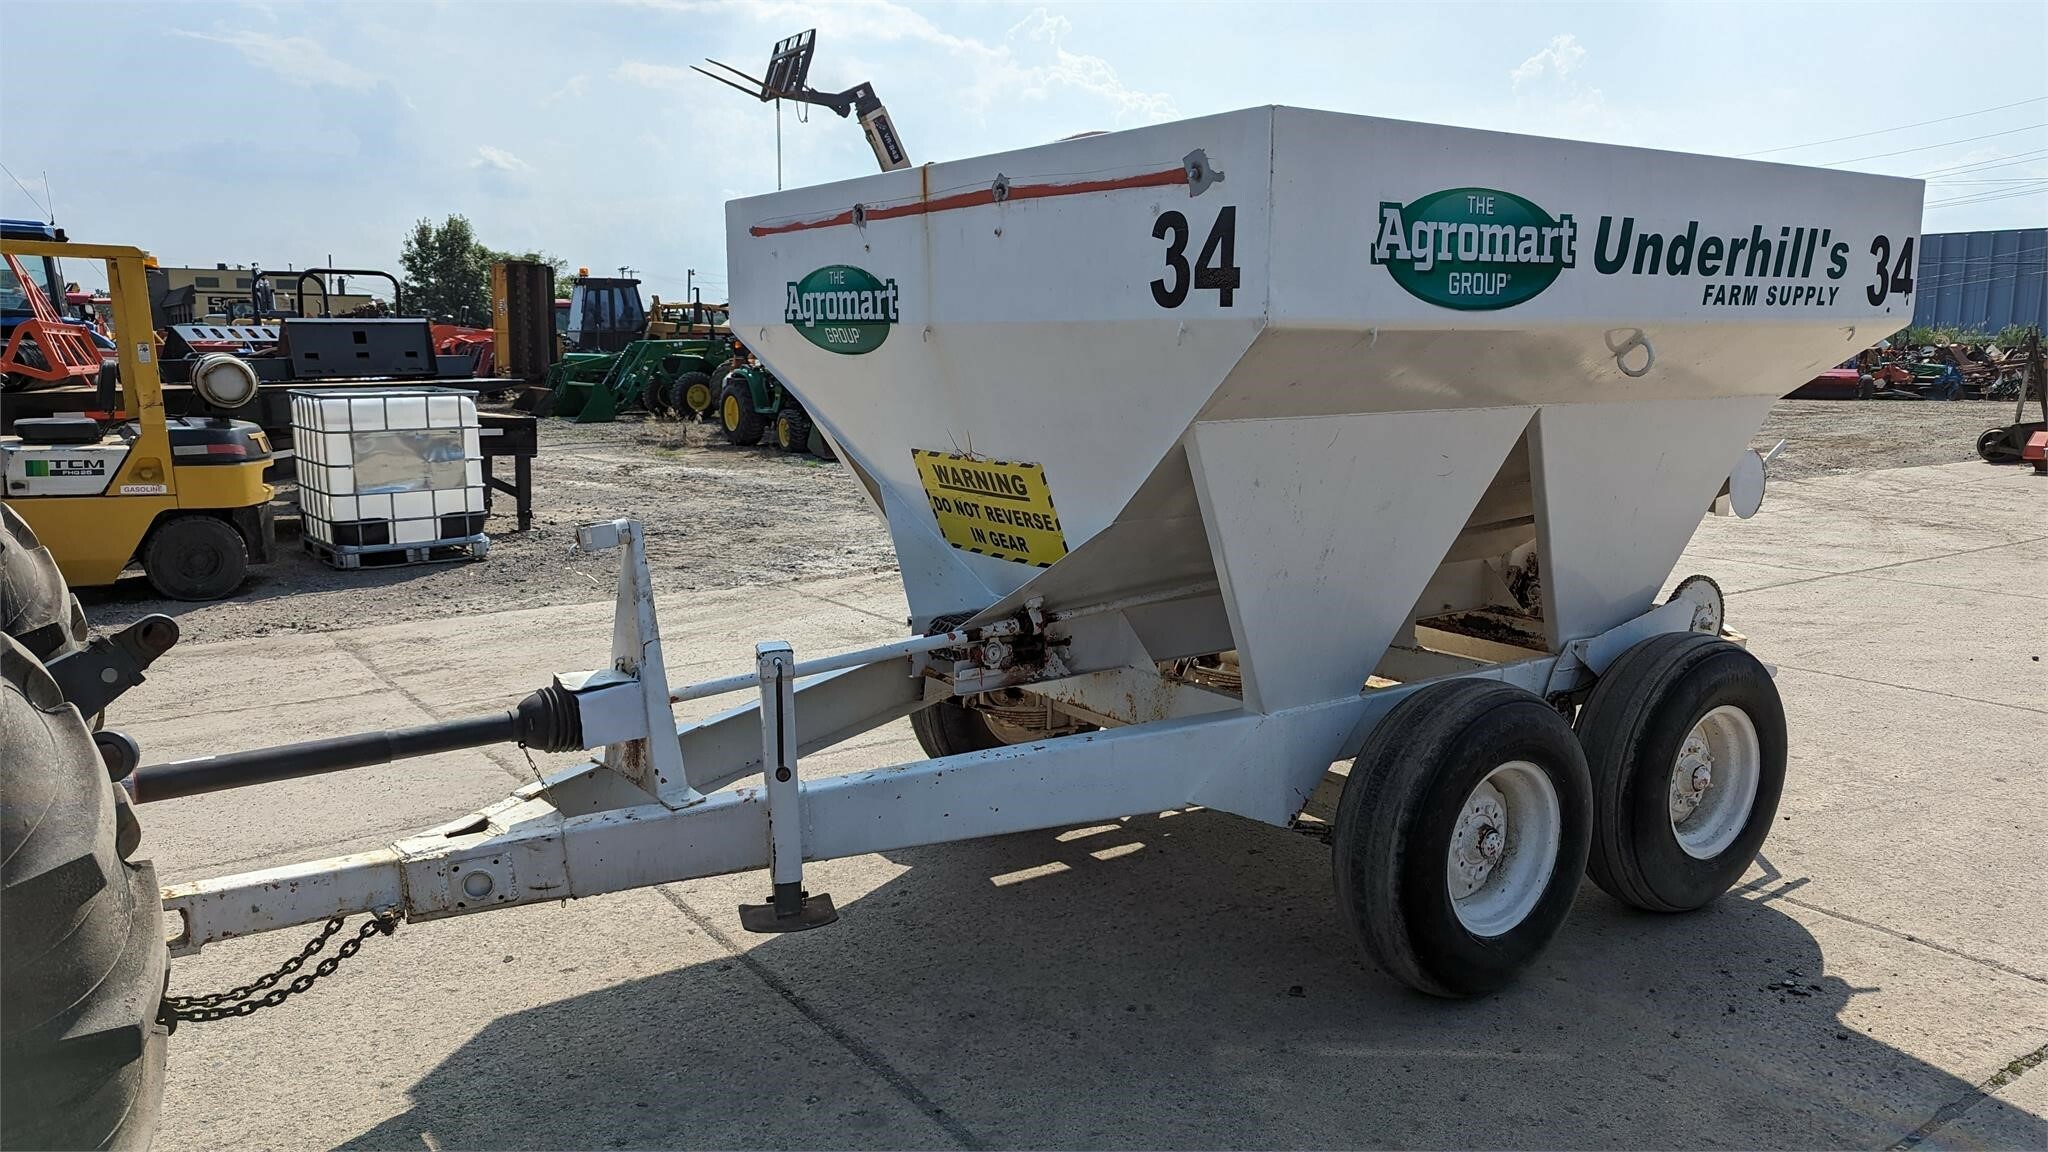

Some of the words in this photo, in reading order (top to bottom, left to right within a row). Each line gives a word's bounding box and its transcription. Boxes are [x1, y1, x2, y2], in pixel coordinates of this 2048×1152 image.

[1467, 195, 1495, 215] THE
[1376, 207, 1575, 272] Agromart
[1594, 215, 1850, 280] Underhill's
[1150, 206, 1241, 309] 34
[1866, 235, 1915, 307] 34
[828, 271, 845, 285] THE
[786, 282, 899, 328] Agromart
[1702, 284, 1758, 306] FARM
[1765, 286, 1840, 306] SUPPLY
[824, 327, 860, 344] GROUP
[49, 459, 105, 469] TCM
[123, 485, 163, 493] GASOLINE
[931, 463, 1028, 496] WARNING
[933, 496, 951, 514] DO
[953, 499, 980, 521] NOT
[986, 505, 1054, 532] REVERSE
[969, 526, 987, 545] IN
[988, 531, 1030, 554] GEAR
